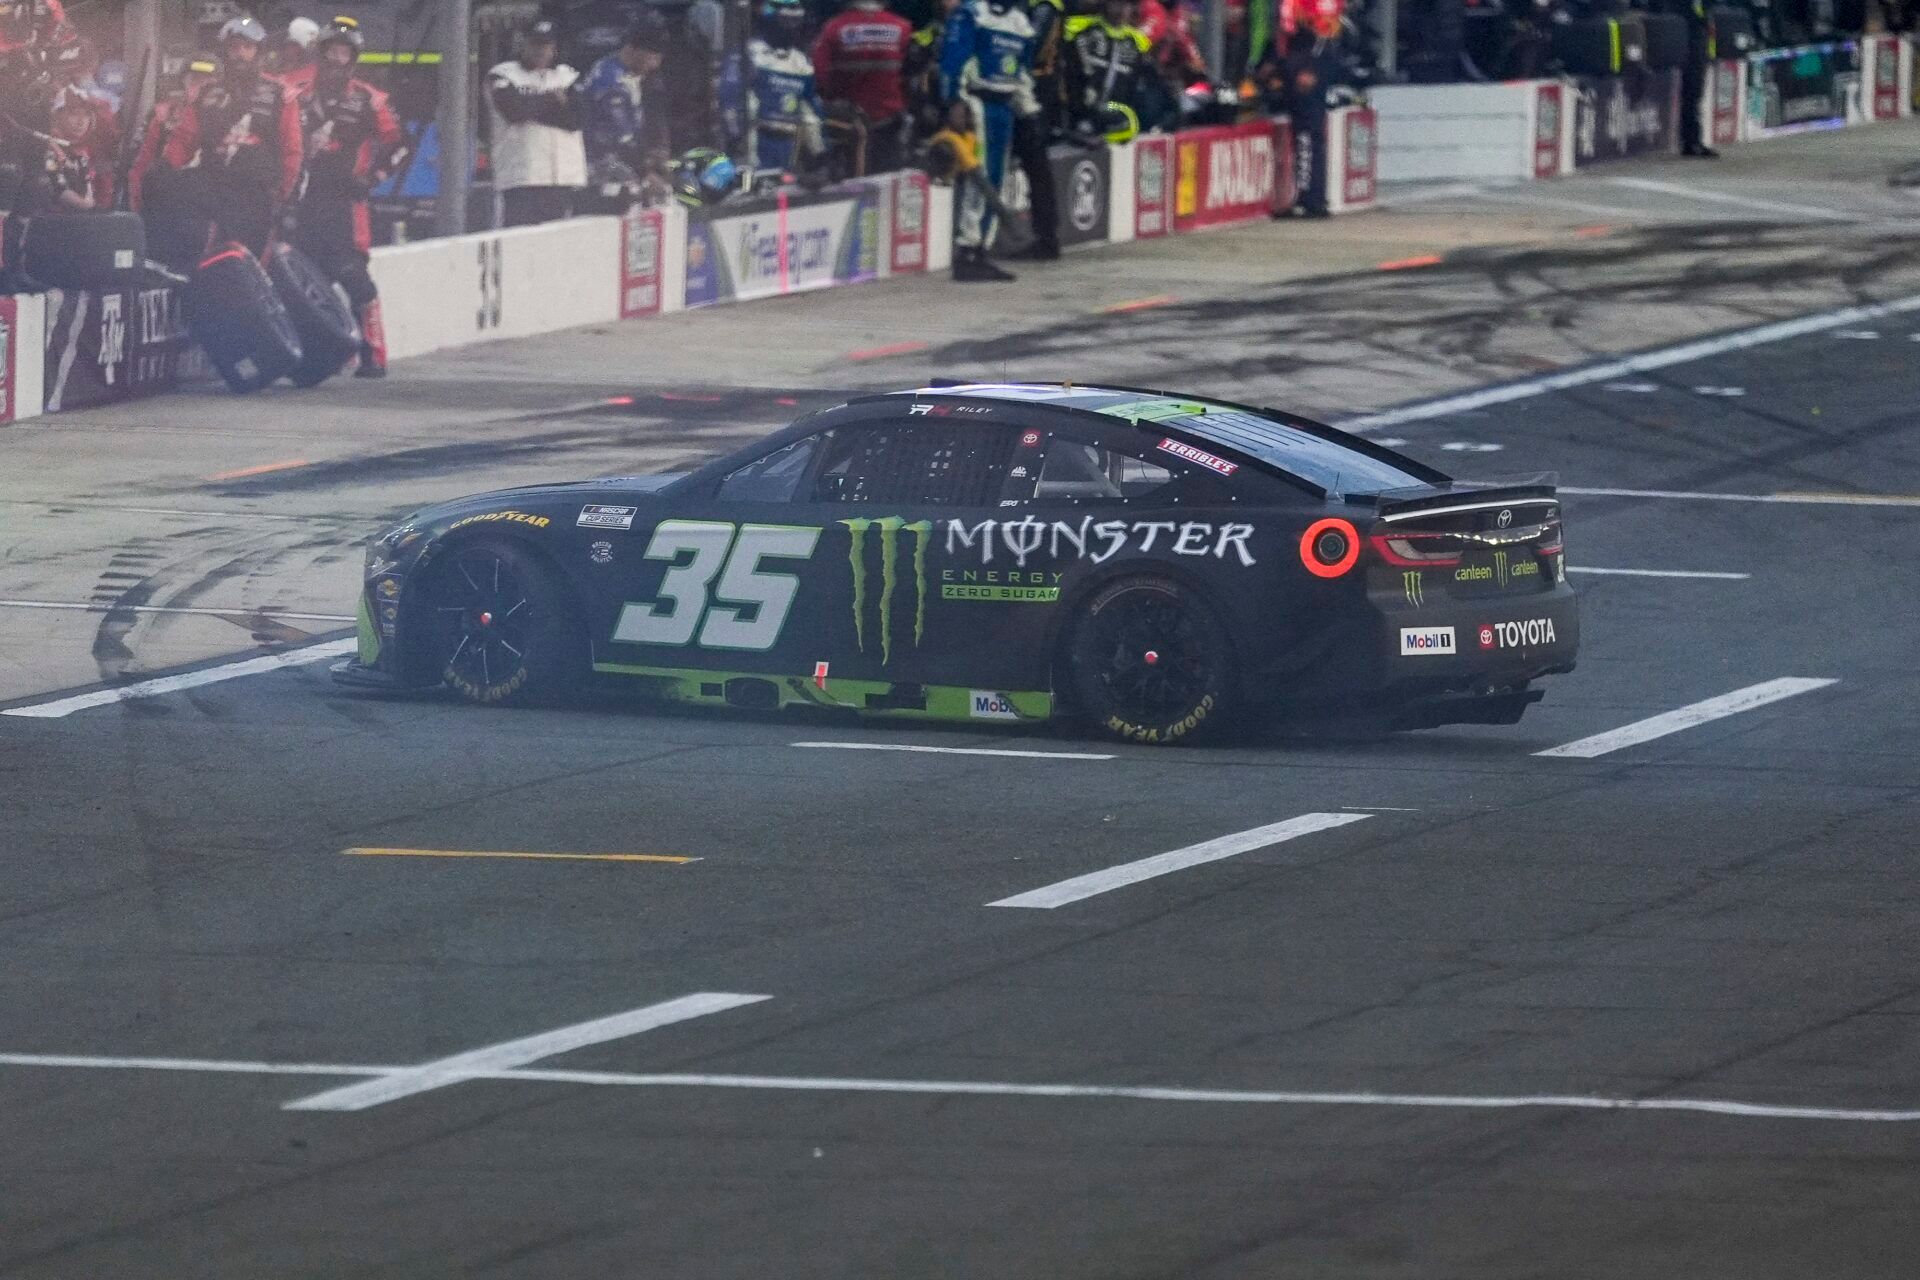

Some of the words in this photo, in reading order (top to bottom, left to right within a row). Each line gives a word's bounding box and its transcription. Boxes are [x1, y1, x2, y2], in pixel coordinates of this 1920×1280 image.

[956, 406, 993, 414] RILEY
[1162, 440, 1233, 472] TERRIBLE'S
[450, 511, 551, 529] GOODYEAR
[945, 515, 1257, 567] MONSTER
[942, 569, 1063, 583] ENERGY
[1455, 565, 1492, 581] canteen
[1511, 560, 1539, 576] canteen
[610, 519, 823, 650] 35
[944, 587, 992, 598] ZERO
[1001, 588, 1059, 600] SUGAR
[1406, 634, 1439, 649] Mobil
[1495, 618, 1556, 648] TOYOTA
